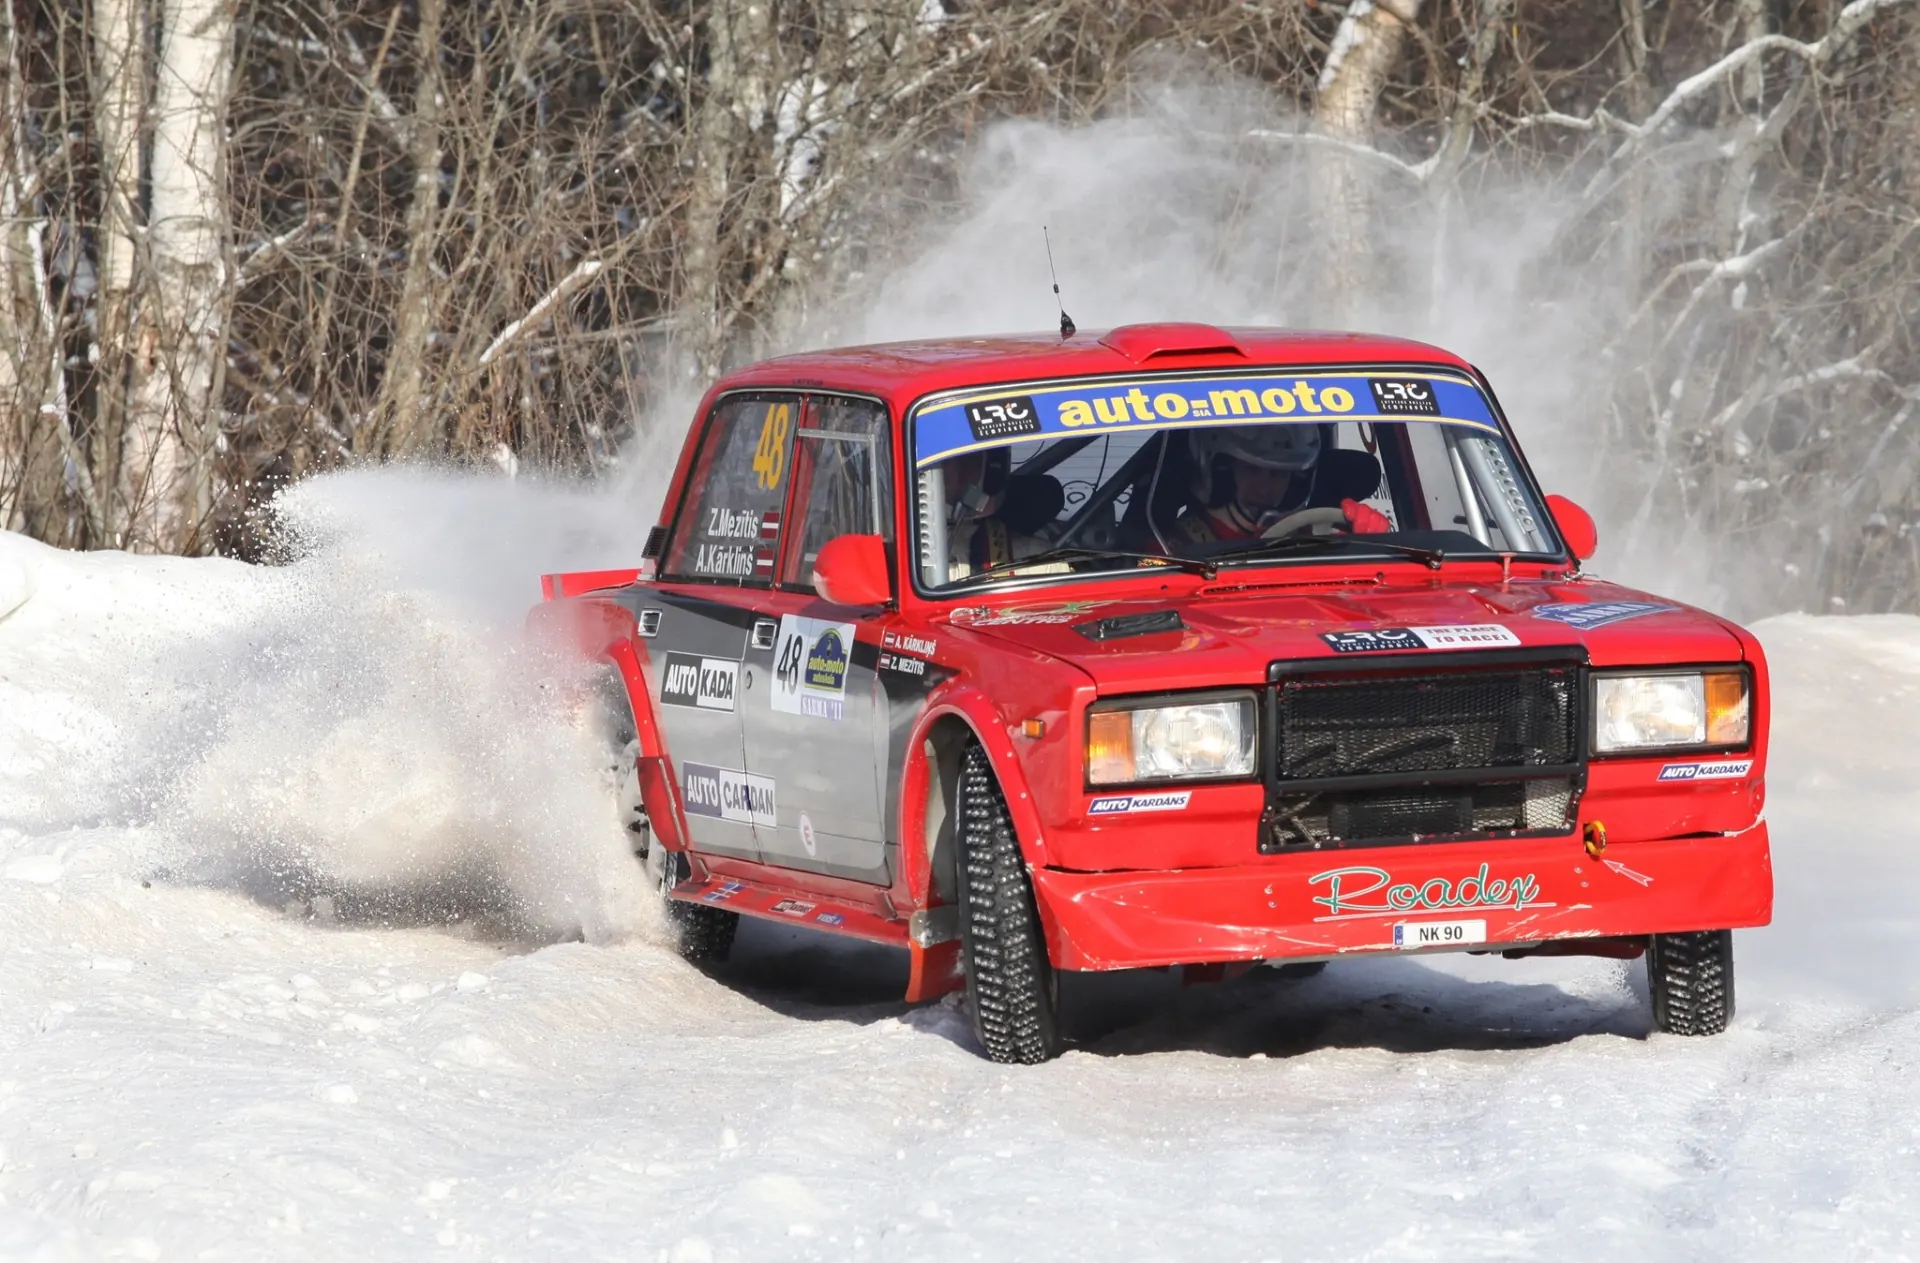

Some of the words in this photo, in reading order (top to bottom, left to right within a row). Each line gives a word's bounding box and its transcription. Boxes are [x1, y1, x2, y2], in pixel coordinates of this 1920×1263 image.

[1057, 380, 1355, 427] auto-moto
[1192, 409, 1212, 417] SIA
[753, 403, 789, 490] 48
[1453, 625, 1499, 634] PLACE
[894, 634, 902, 649] A.
[1432, 636, 1454, 644] TO
[1459, 634, 1509, 643] RACE!
[777, 633, 803, 696] 48
[890, 656, 898, 671] Z.
[665, 664, 698, 696] AUTO
[700, 668, 734, 700] KADA
[802, 697, 828, 718] SARMA
[1662, 766, 1696, 778] AUTO
[1698, 764, 1749, 775] KARDANS
[687, 774, 719, 807] AUTO
[723, 781, 774, 816] CARDAN
[1092, 799, 1129, 811] AUTO
[1132, 796, 1187, 808] KARDANS
[1308, 862, 1541, 914] Roadex
[1419, 927, 1440, 941] NK
[1444, 926, 1464, 940] 90
